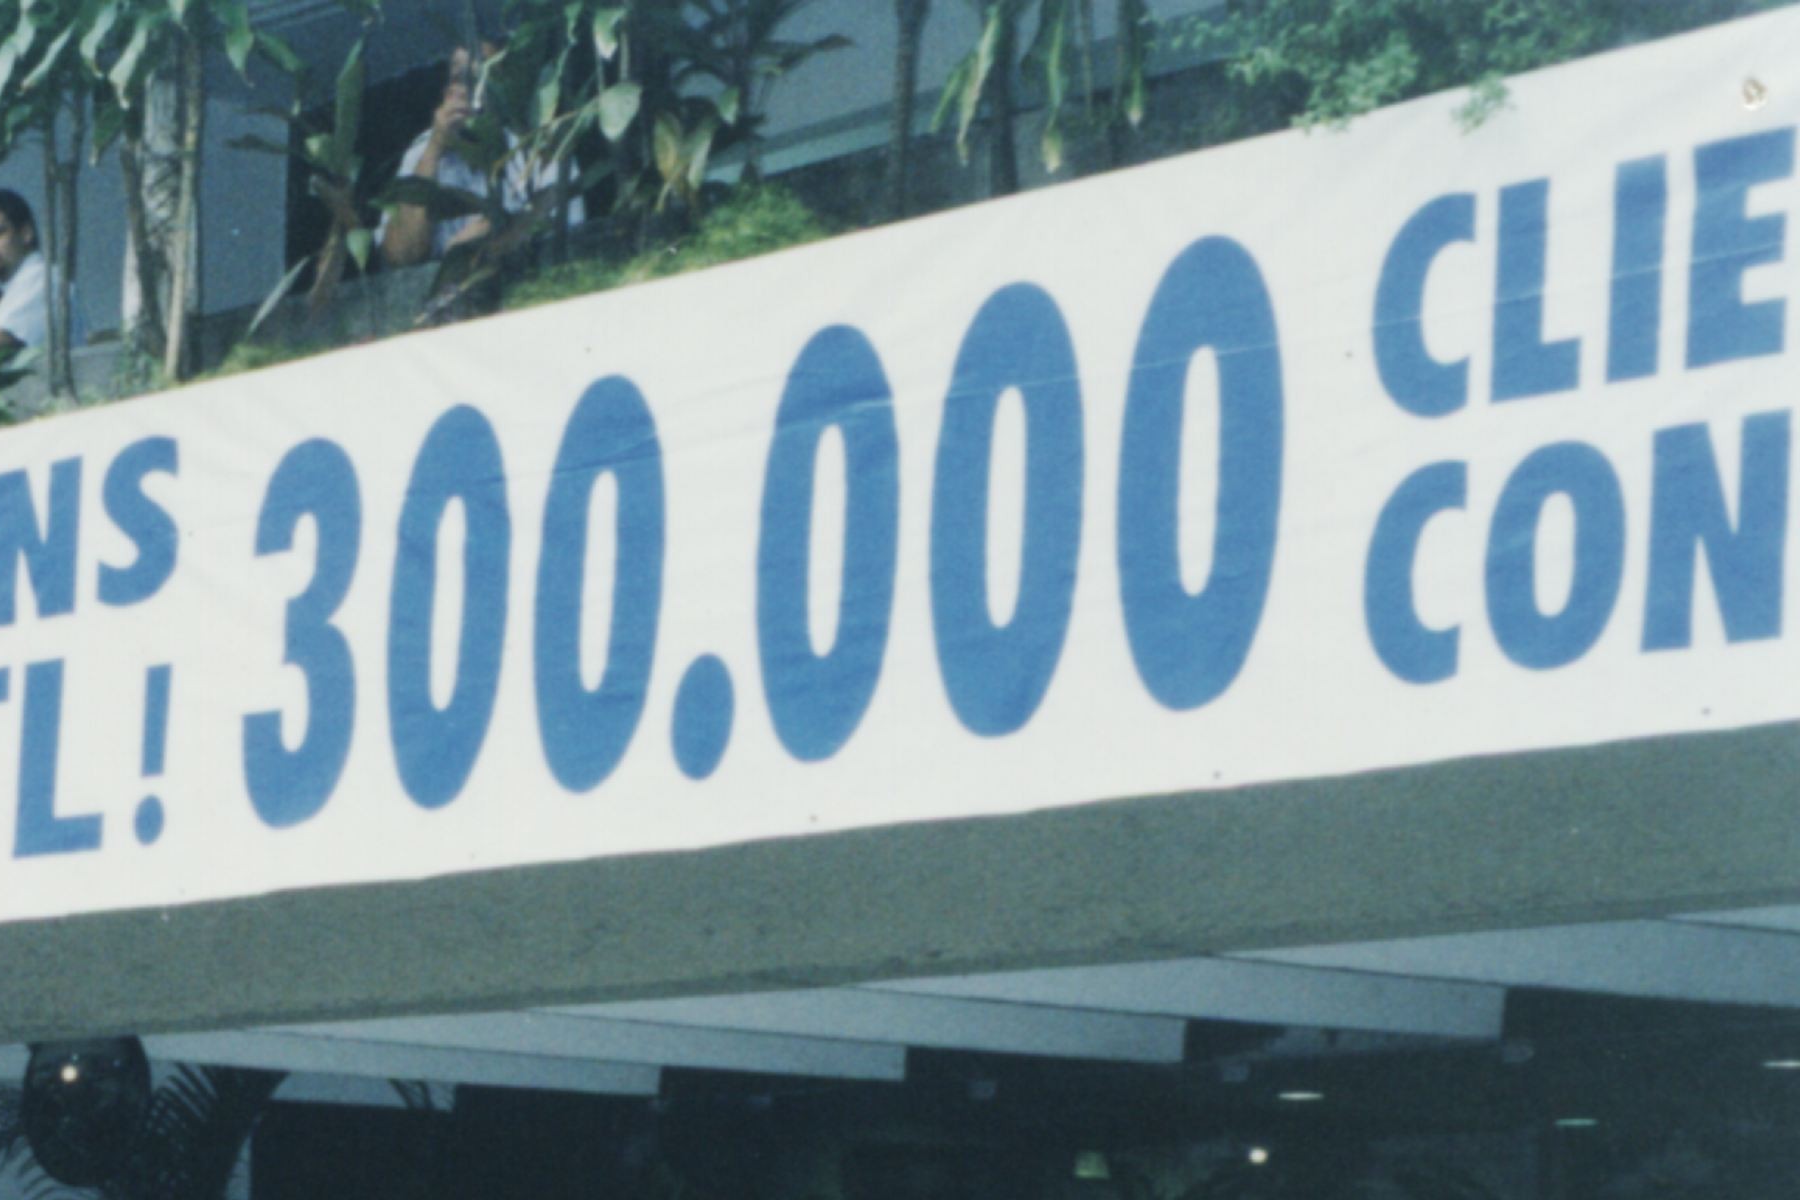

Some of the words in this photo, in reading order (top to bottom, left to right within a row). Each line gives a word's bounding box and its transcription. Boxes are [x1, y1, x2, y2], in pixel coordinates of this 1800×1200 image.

[1372, 125, 1797, 419] CLIE
[242, 234, 1285, 829] 300.000
[1363, 407, 1793, 686] CON
